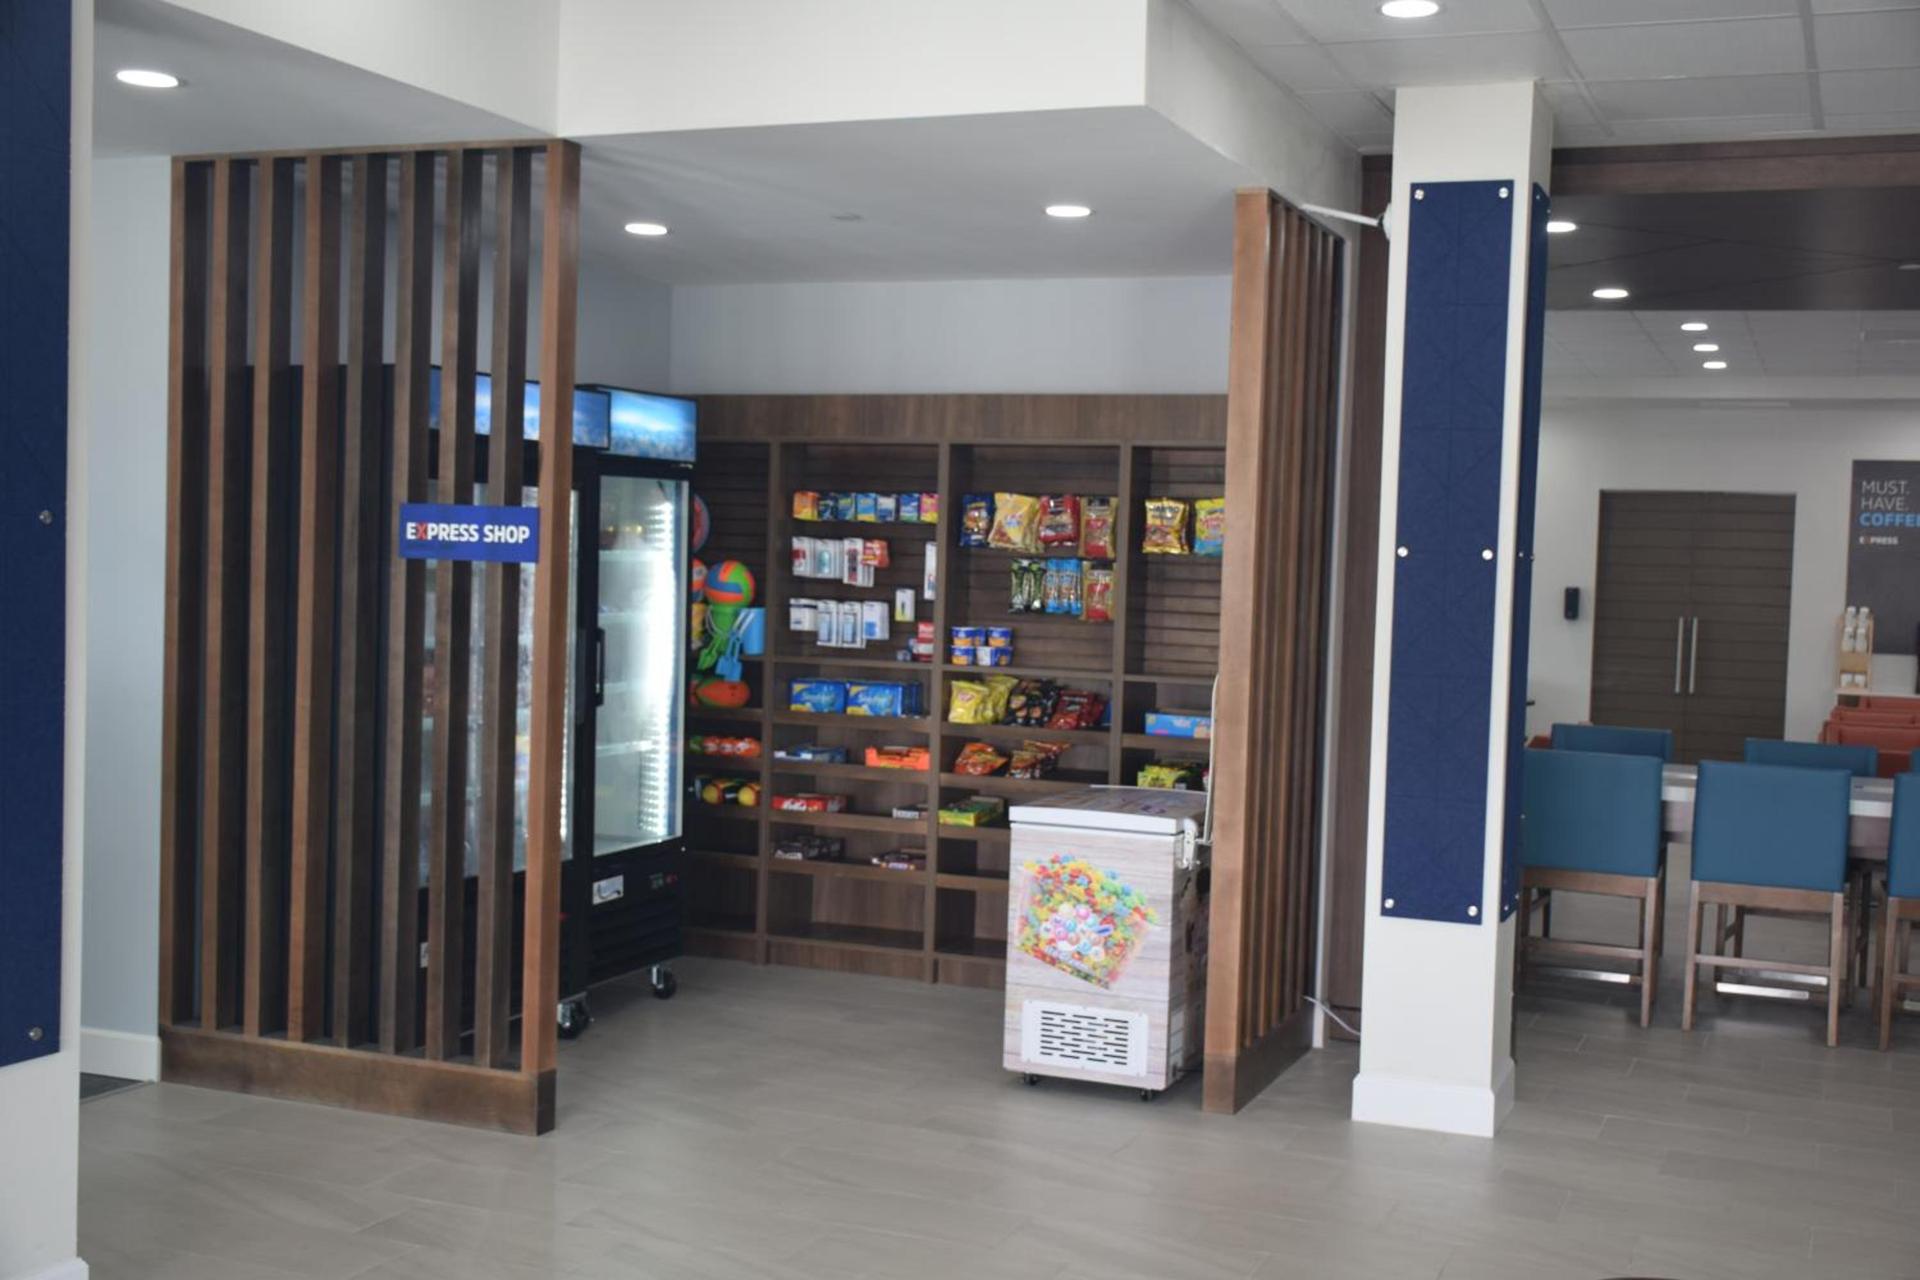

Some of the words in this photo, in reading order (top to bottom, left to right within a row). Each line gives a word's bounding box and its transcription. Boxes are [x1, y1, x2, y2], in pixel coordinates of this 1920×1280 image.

[1862, 480, 1910, 495] MUST.
[1861, 497, 1909, 511] HAVE.
[406, 522, 479, 542] EXPRESS
[483, 524, 530, 544] SHOP
